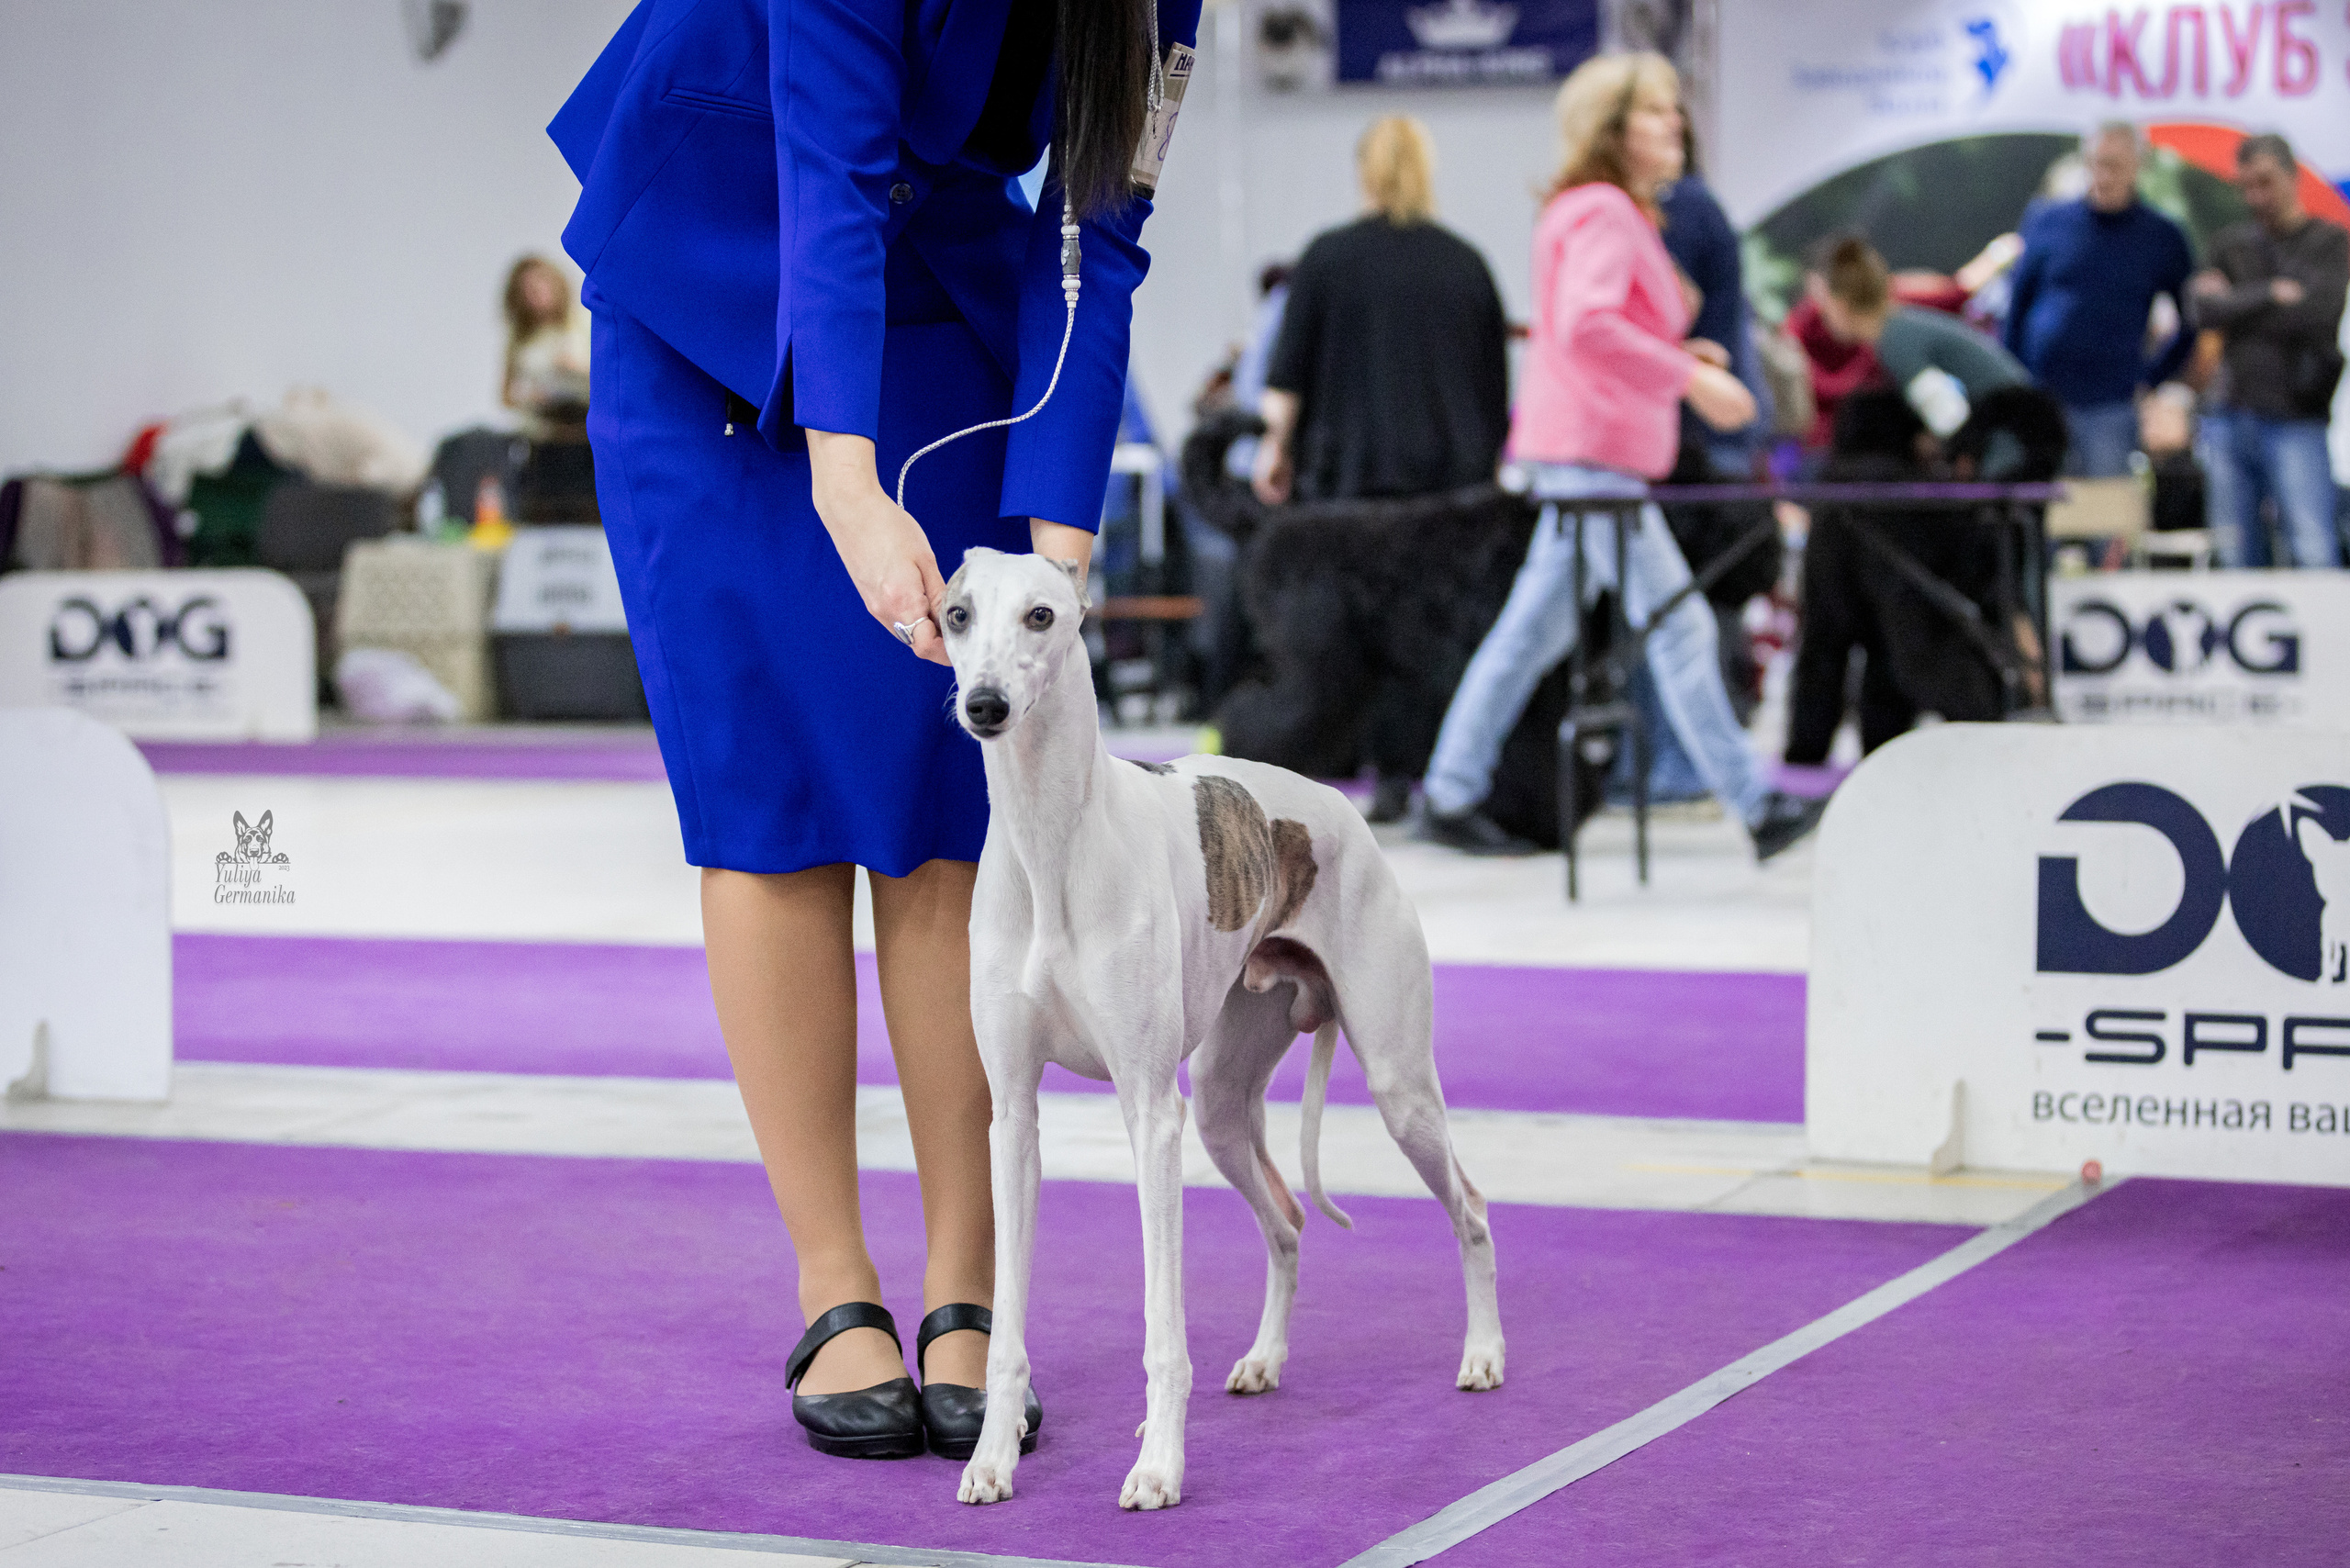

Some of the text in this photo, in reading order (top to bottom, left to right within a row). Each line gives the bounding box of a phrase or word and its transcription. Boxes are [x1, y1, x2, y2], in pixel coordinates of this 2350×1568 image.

[50, 597, 228, 662] DOG
[2062, 601, 2300, 675] DOG
[2032, 1091, 2350, 1135] вселенная ва
